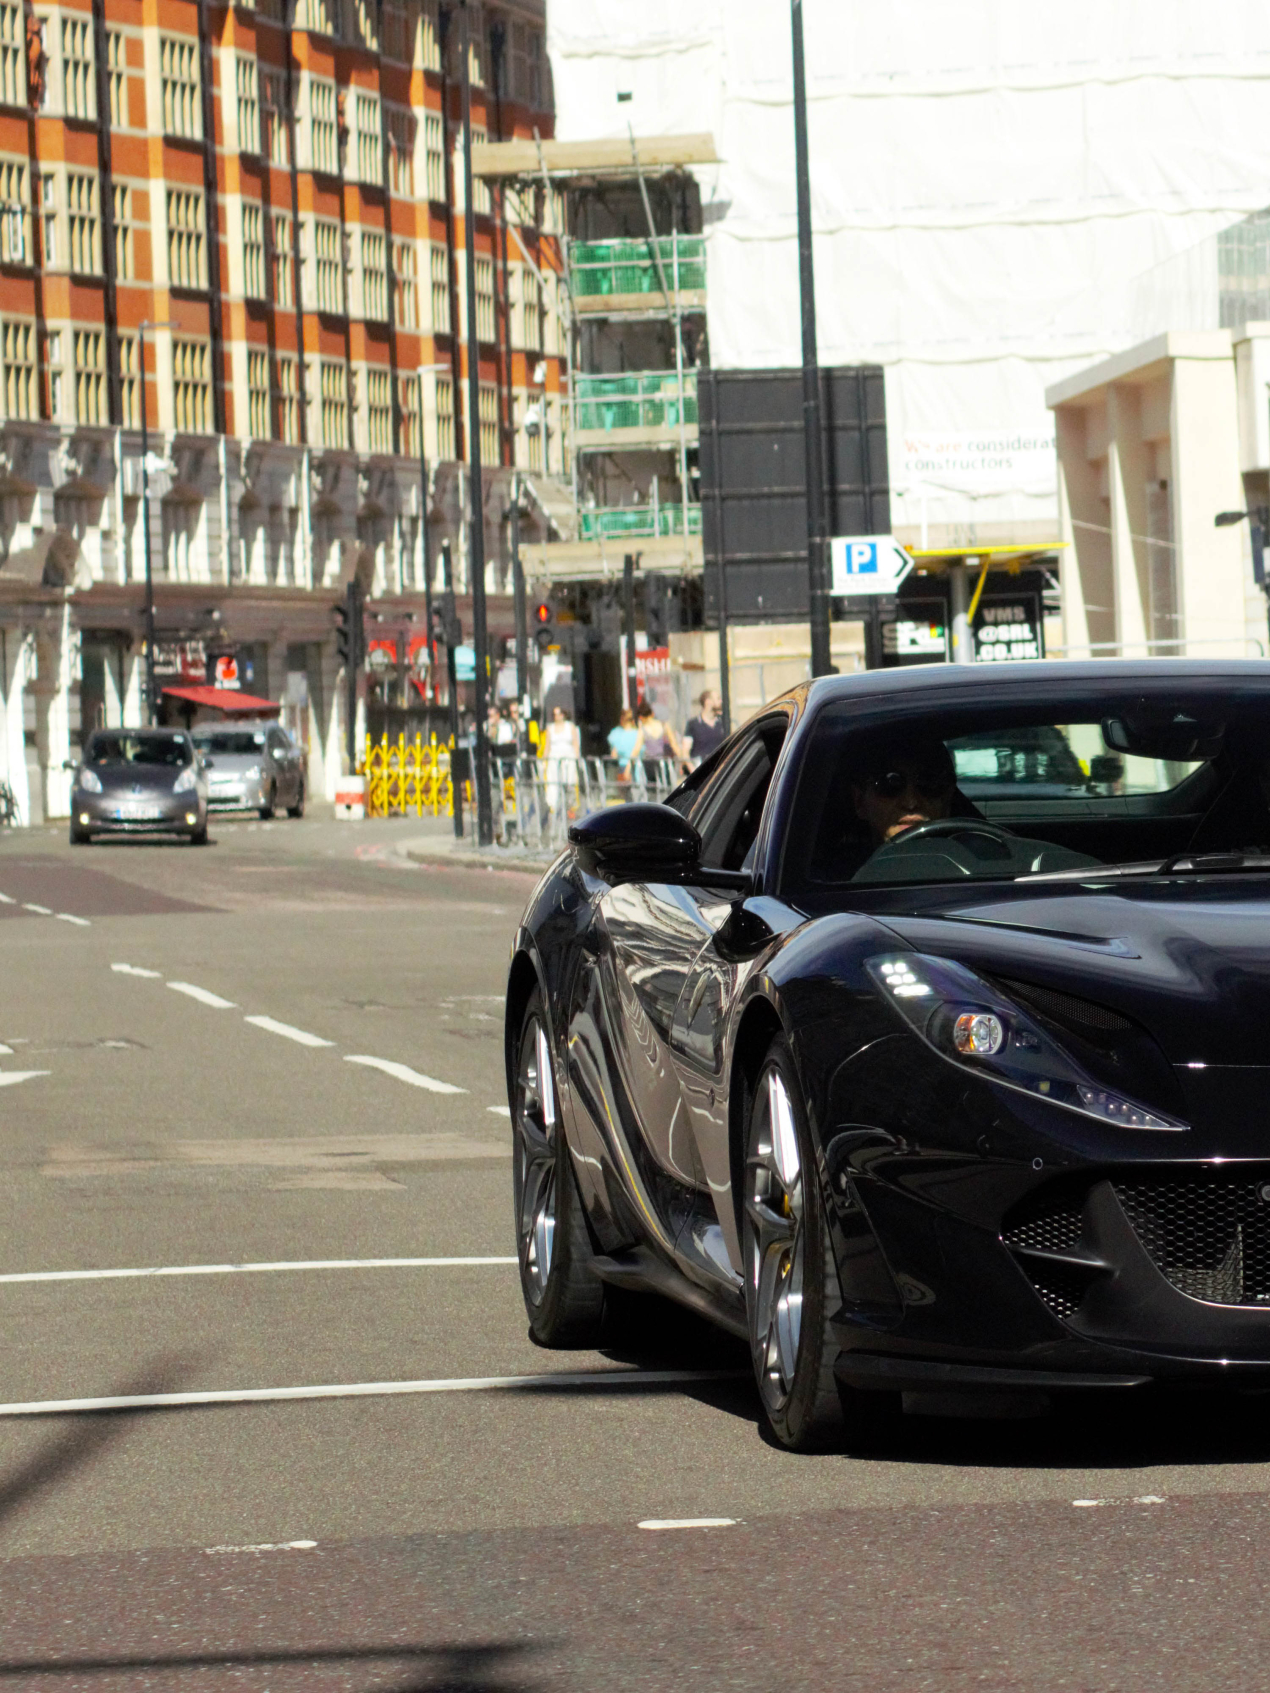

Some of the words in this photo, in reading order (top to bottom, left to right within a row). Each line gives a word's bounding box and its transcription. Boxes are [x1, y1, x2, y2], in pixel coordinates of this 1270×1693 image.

[936, 441, 962, 453] are
[905, 456, 1013, 472] constructors
[851, 543, 872, 573] P
[983, 605, 1026, 622] VMS
[978, 623, 1034, 643] @SRL
[976, 641, 1039, 662] .CO.UK
